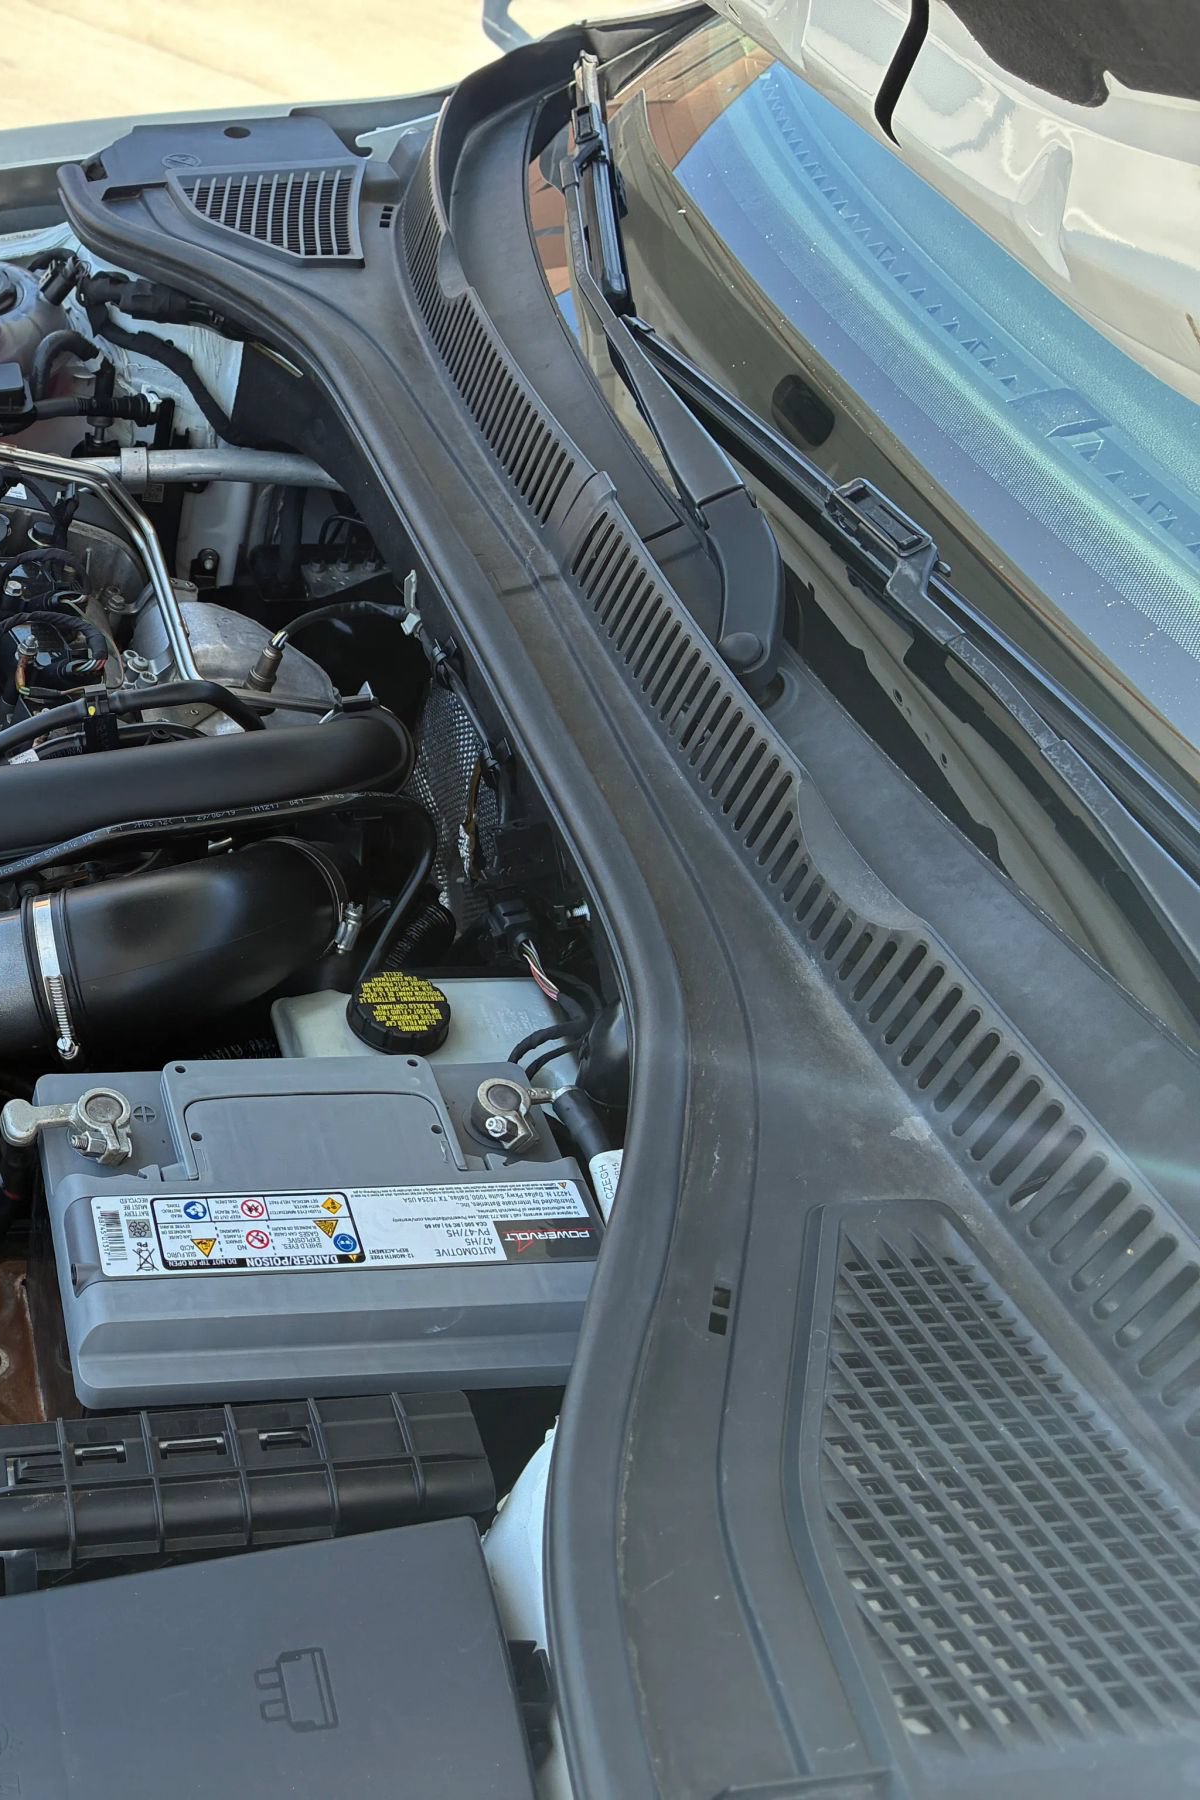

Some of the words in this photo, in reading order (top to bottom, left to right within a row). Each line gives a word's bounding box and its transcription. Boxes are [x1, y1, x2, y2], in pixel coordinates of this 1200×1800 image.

[598, 1163, 615, 1200] CZECH
[445, 1227, 490, 1237] PV-47/H5
[502, 1229, 590, 1240] POWERVOLT
[463, 1236, 494, 1245] 47/H5
[433, 1246, 497, 1256] AUTOMOTIVE
[244, 1254, 338, 1266] DANGER/POISON
